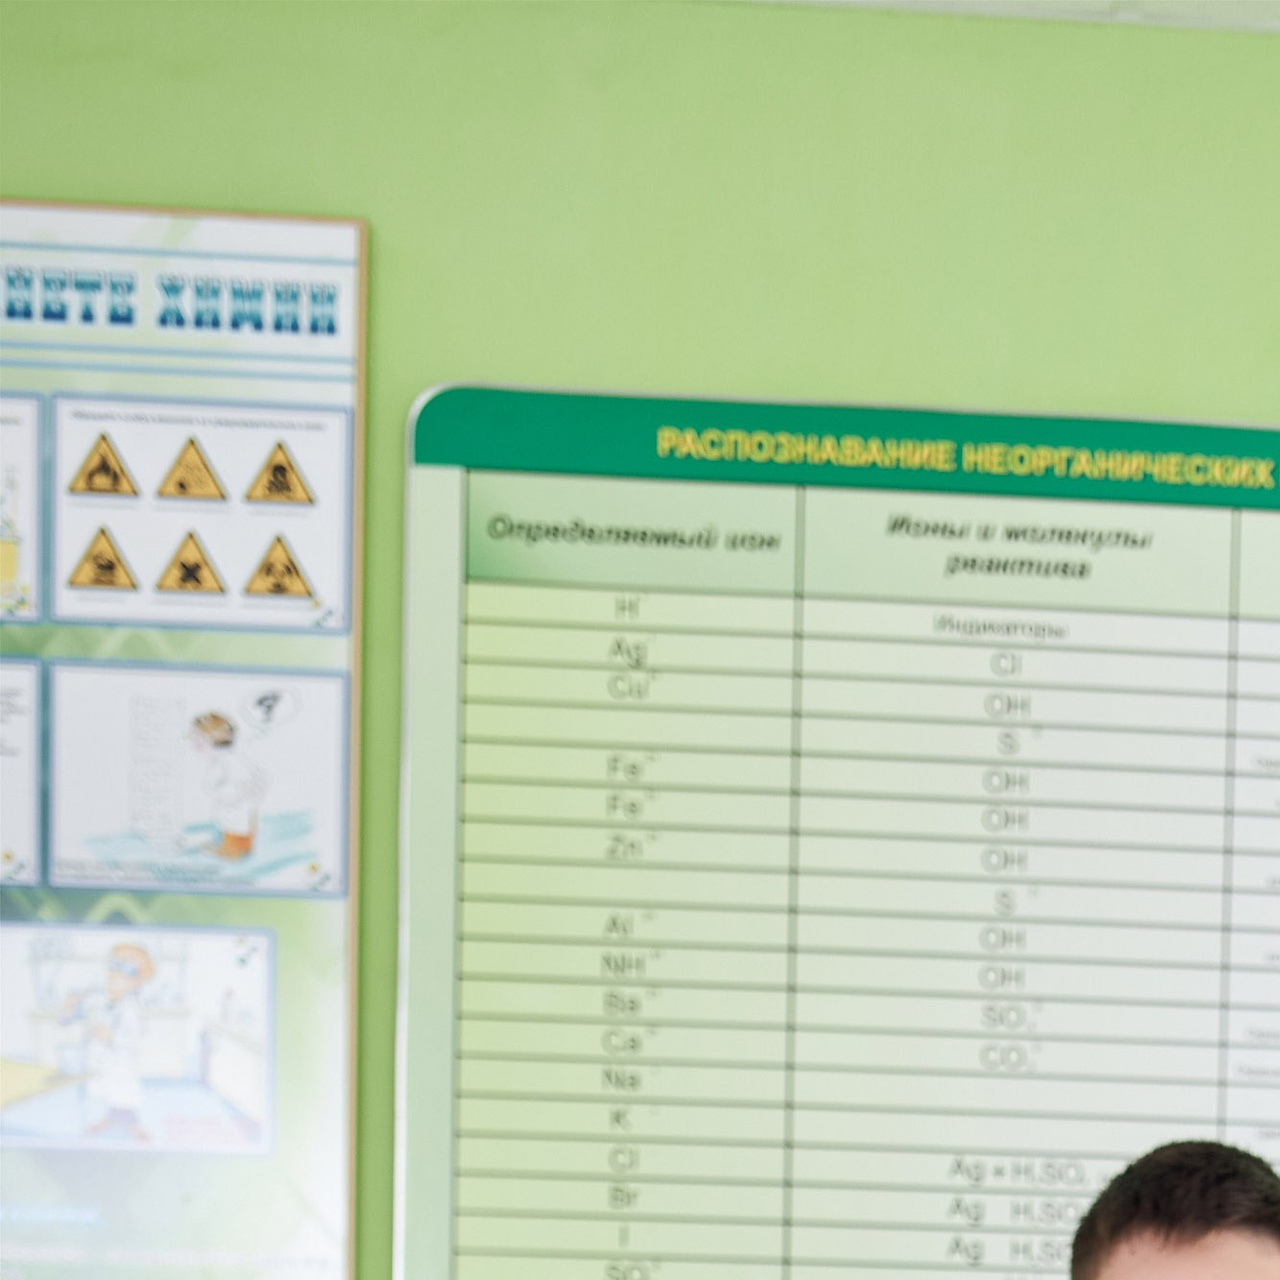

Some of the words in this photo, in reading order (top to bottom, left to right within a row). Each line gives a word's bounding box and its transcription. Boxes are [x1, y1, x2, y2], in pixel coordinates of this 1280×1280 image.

[656, 425, 956, 473] РАСПОЗНАВАНИЕ
[962, 442, 1275, 490] НЕОРГАНИЧЕСКИХ
[486, 512, 718, 549] Определяемый
[725, 531, 781, 552] ион
[886, 513, 970, 541] Ионы
